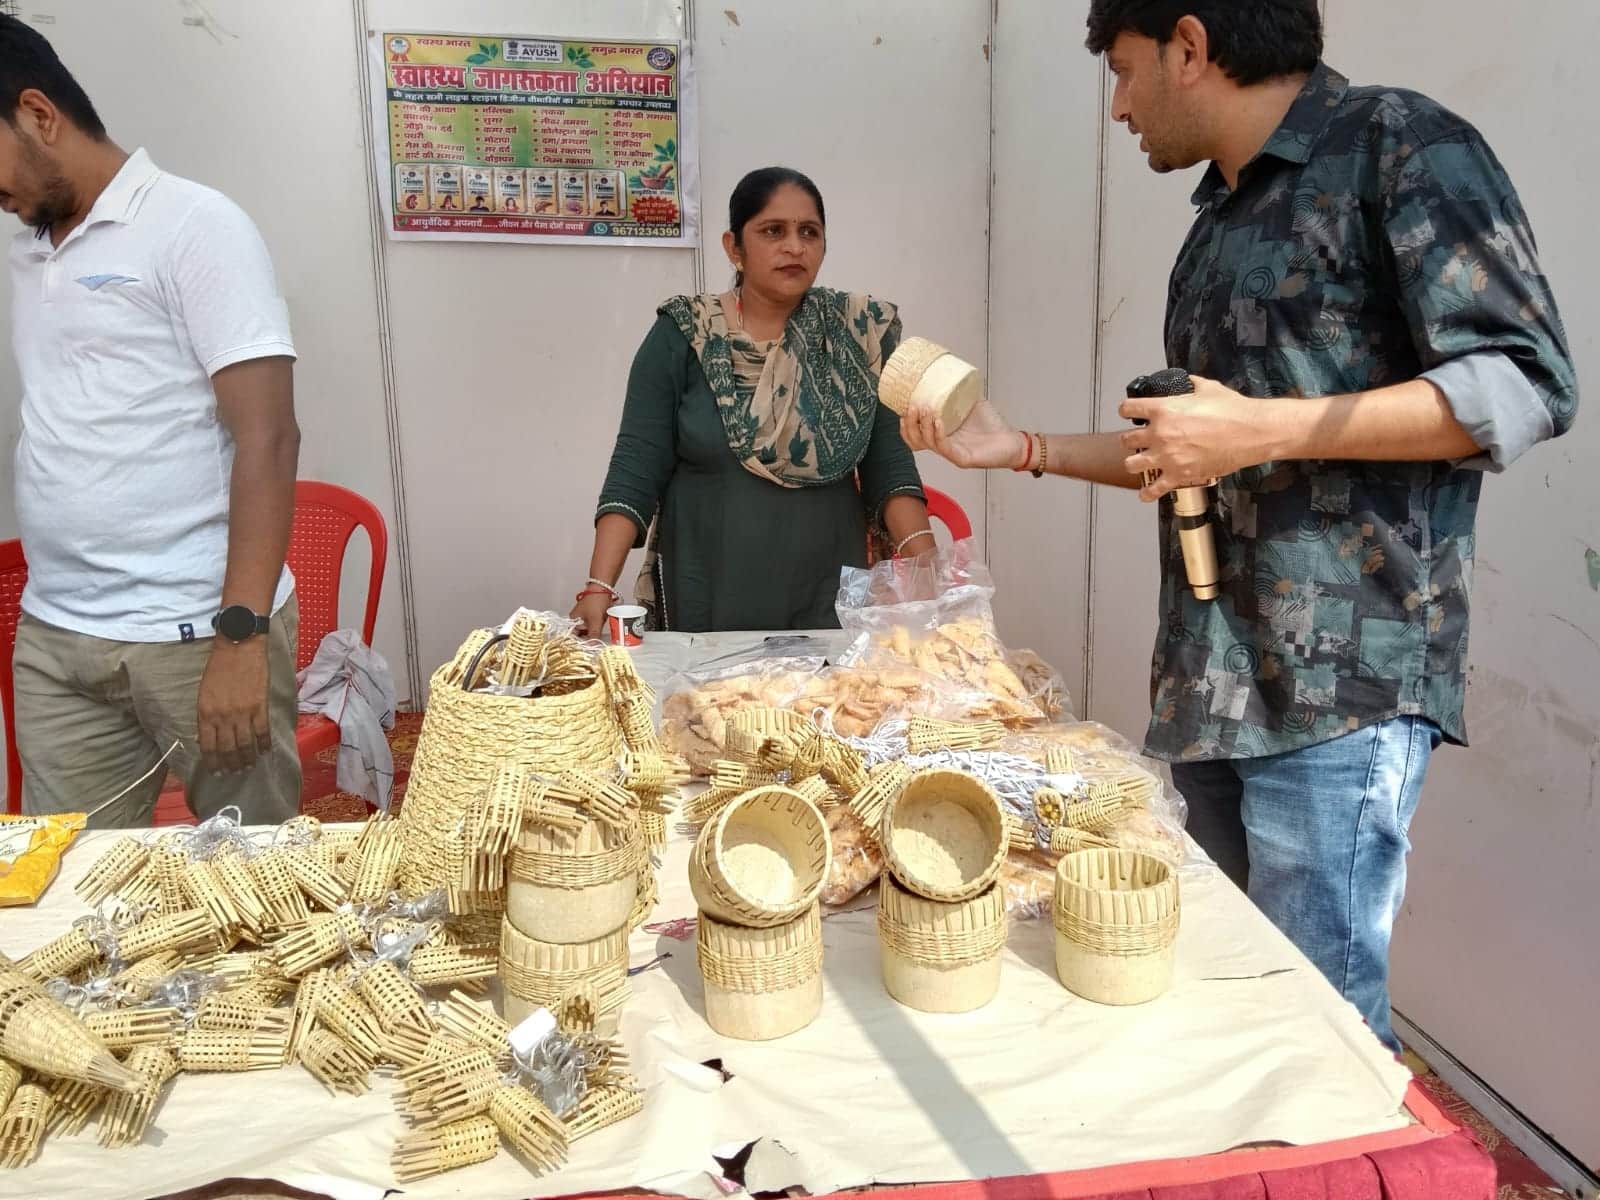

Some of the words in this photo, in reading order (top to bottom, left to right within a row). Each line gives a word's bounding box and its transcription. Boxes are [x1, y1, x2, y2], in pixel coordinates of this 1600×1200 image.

[445, 40, 471, 48] भारत
[522, 49, 557, 57] AYUSH
[391, 64, 466, 88] स्वास्थ्य
[585, 66, 672, 97] अभियान
[612, 226, 679, 236] 9671234390
